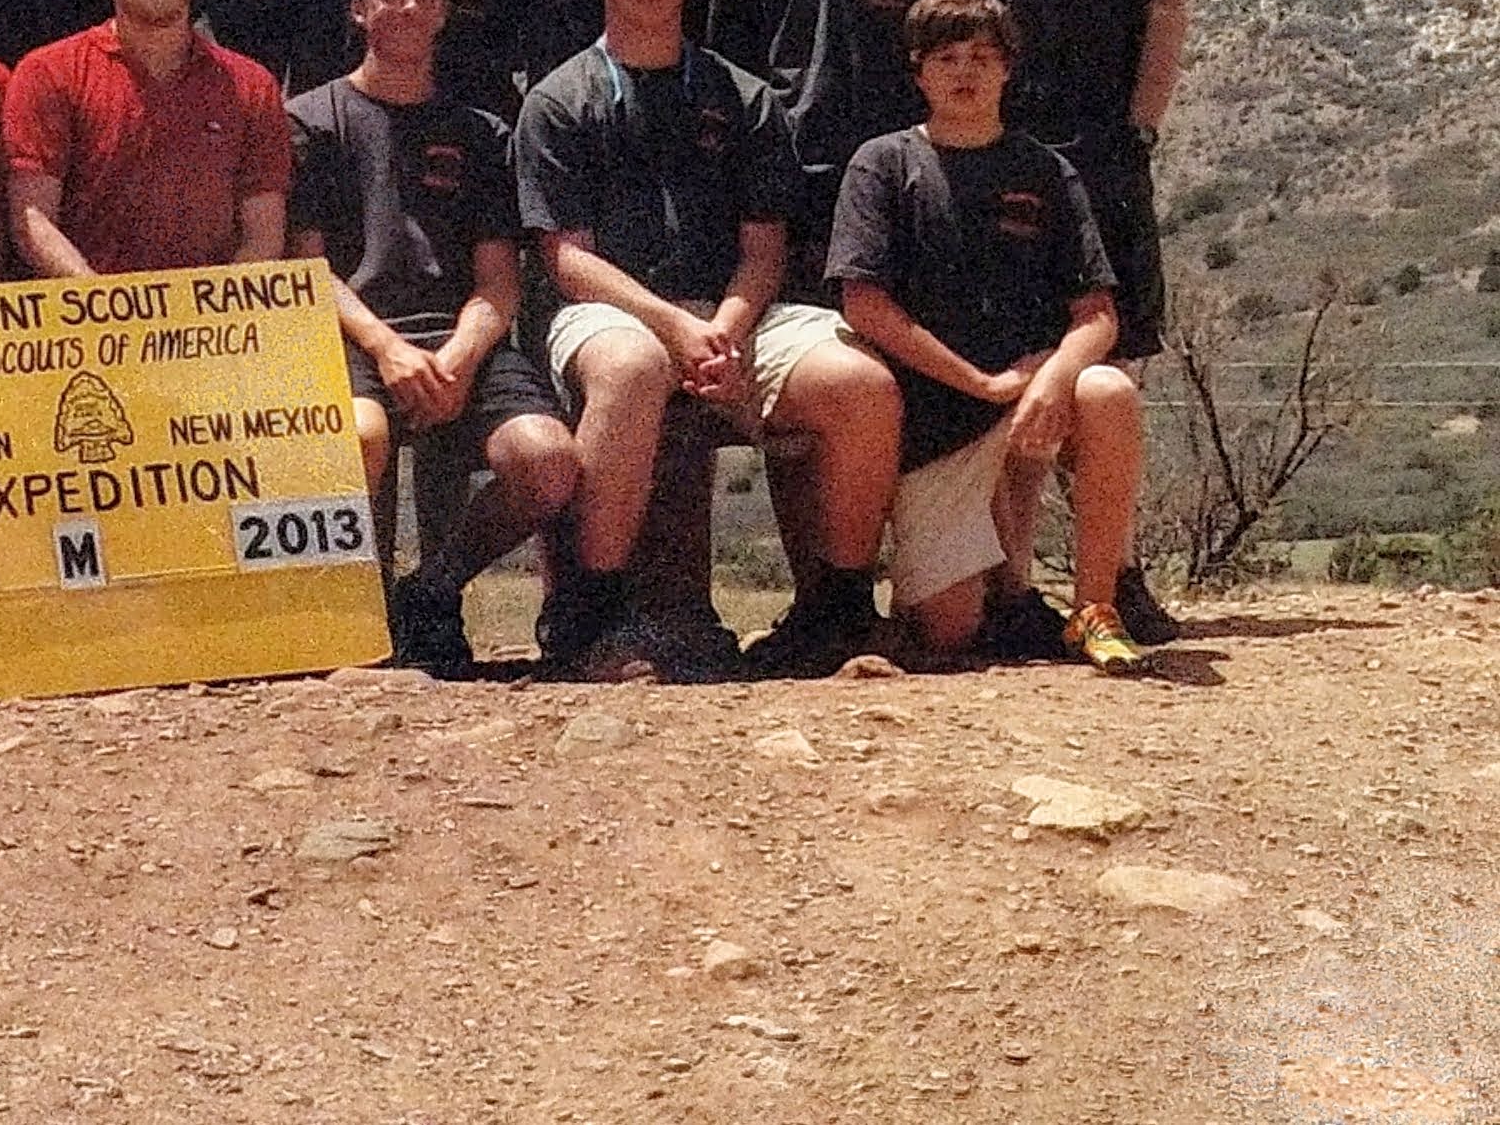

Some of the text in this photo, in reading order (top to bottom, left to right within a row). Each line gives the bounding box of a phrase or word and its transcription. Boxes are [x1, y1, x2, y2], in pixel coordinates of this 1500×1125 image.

[61, 283, 170, 325] SCOUT
[193, 271, 314, 315] RANCH
[100, 333, 130, 366] OF
[141, 322, 259, 361] AMERICA
[170, 404, 342, 445] NEW MEXICO
[60, 533, 100, 580] M
[238, 509, 363, 560] 2013
